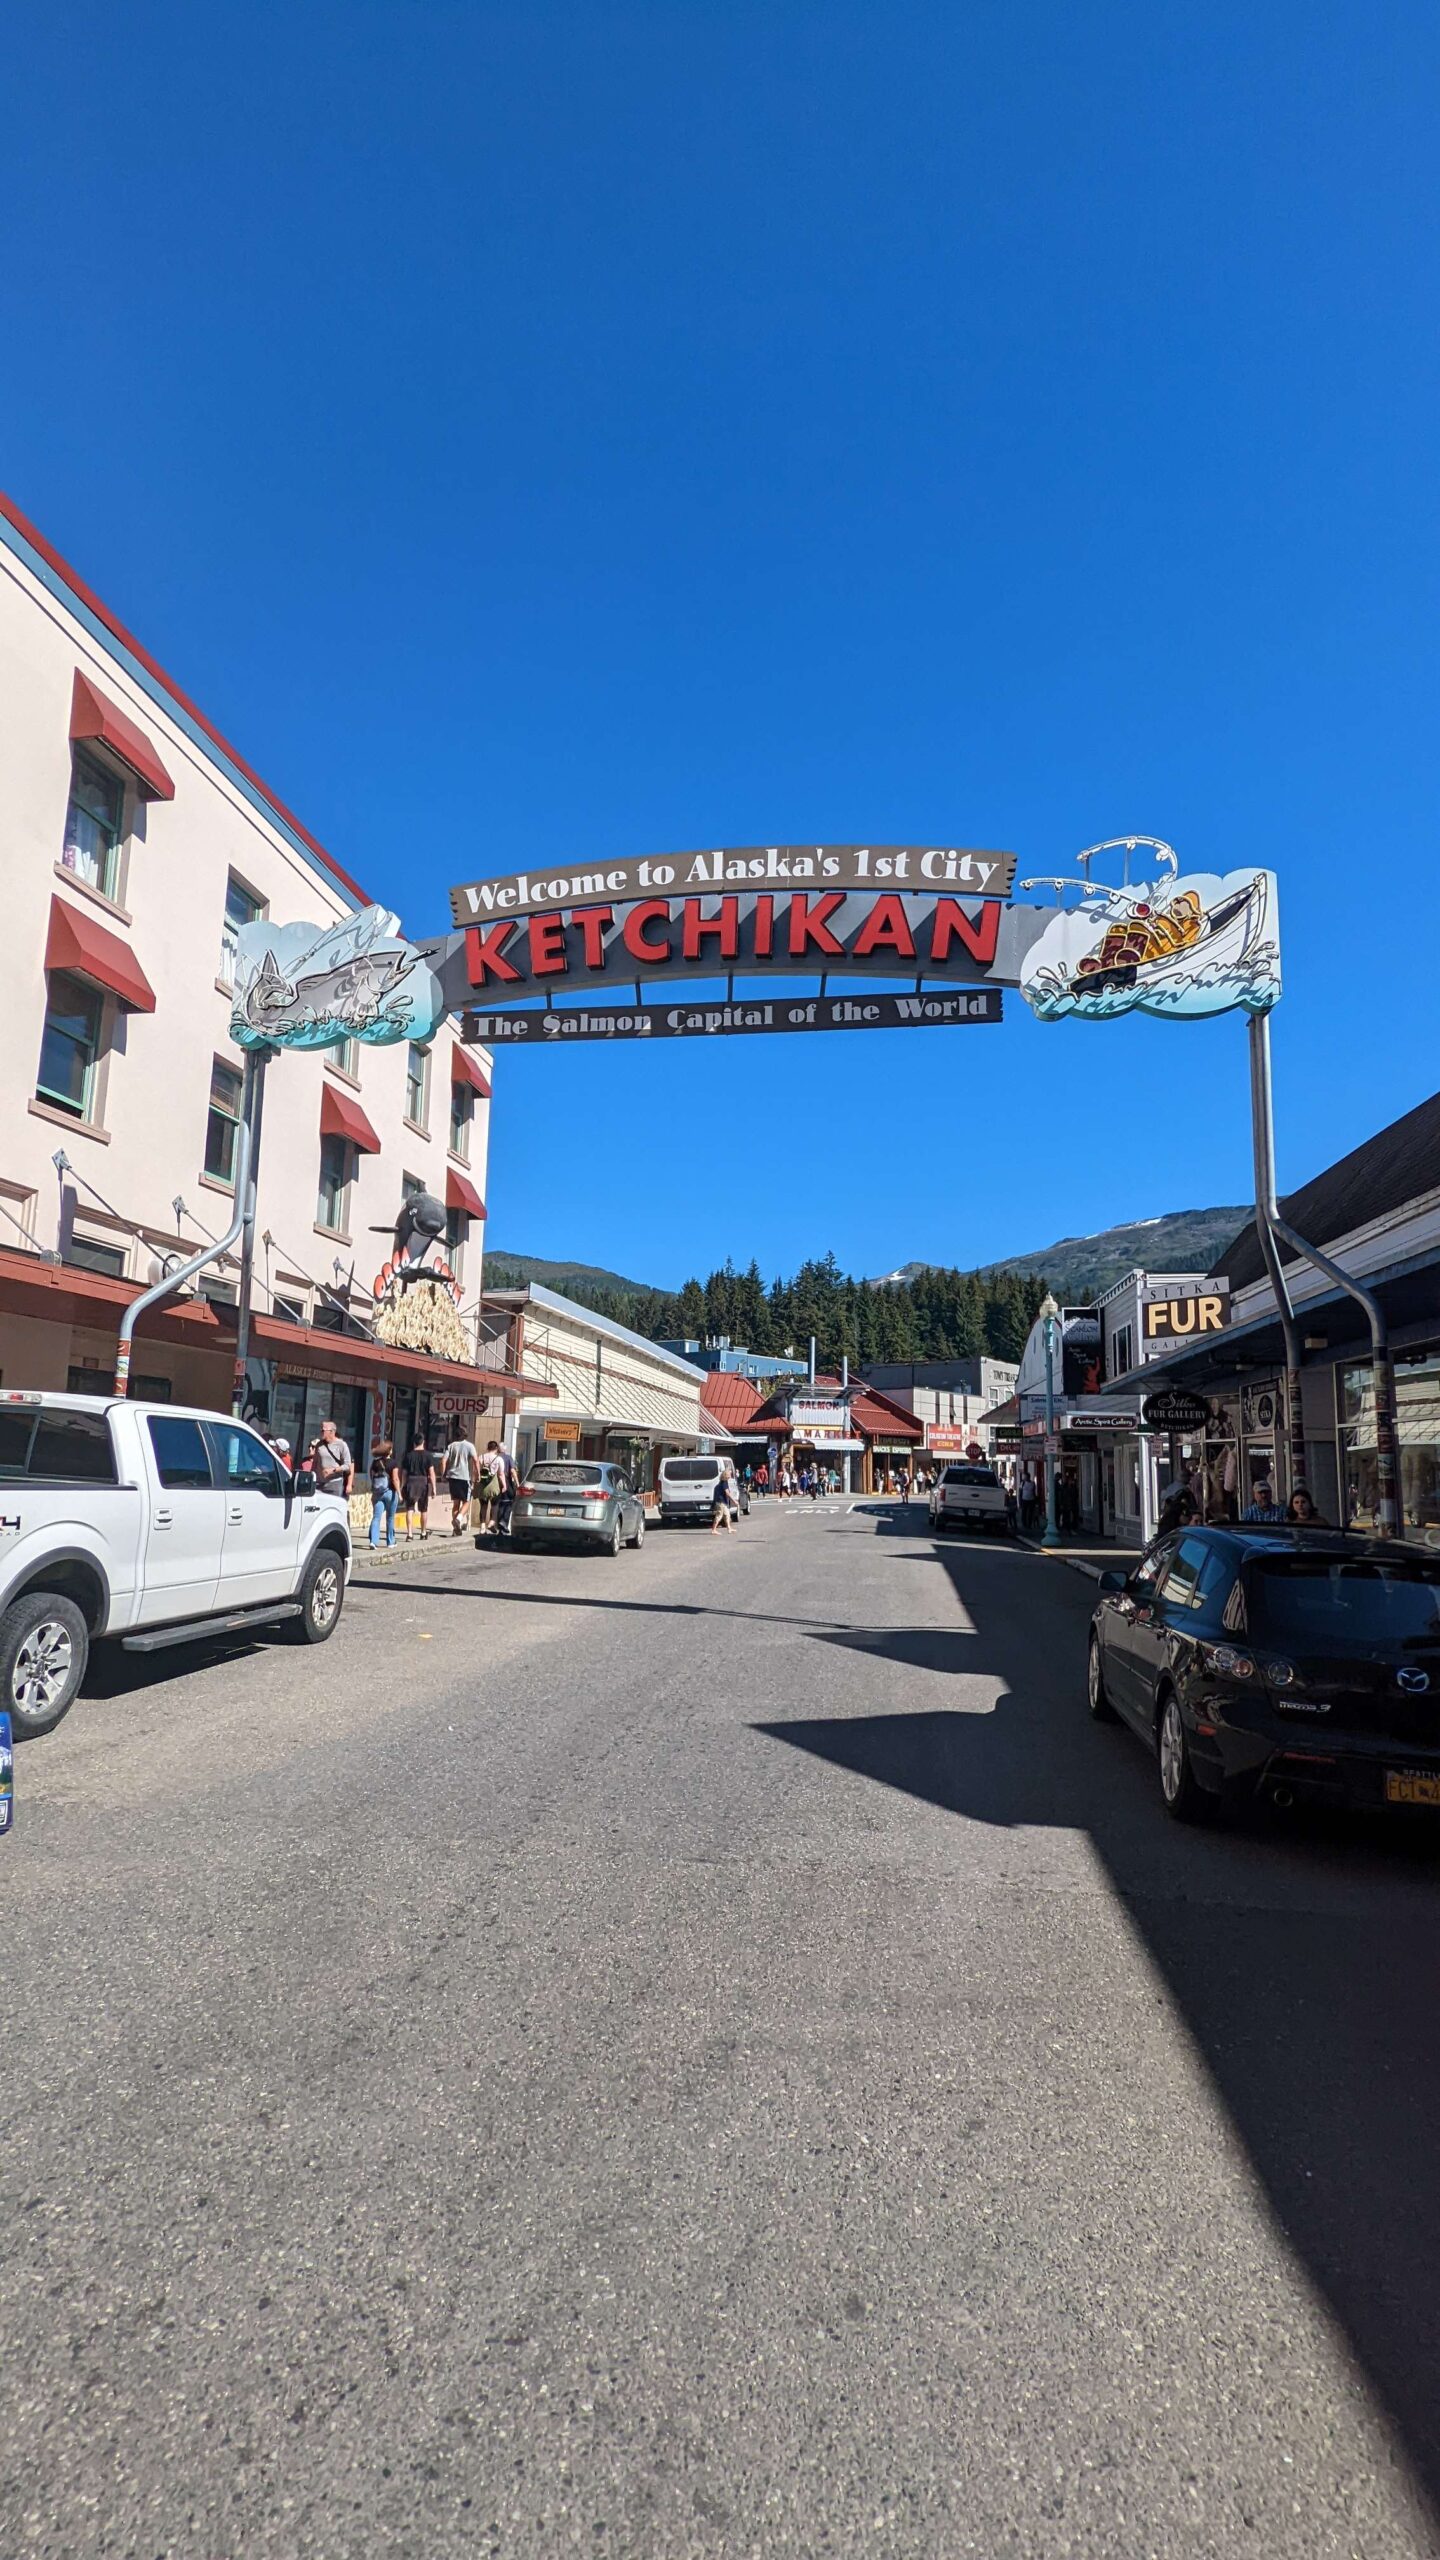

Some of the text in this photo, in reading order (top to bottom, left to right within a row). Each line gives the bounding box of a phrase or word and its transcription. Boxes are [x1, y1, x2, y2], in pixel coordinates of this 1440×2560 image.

[463, 848, 1000, 914] Welcome to Alaska's 1st City
[464, 892, 1002, 989] KETCHIKAN
[473, 995, 988, 1037] The Salmon Capital of the World
[1150, 1281, 1220, 1300] SITKA
[1148, 1296, 1223, 1336] FUR
[434, 1397, 486, 1412] TOURS
[798, 1400, 840, 1410] SALMON
[1093, 1418, 1111, 1426] Spirit
[1111, 1418, 1133, 1426] Gallery
[1148, 1410, 1206, 1419] FUR GALLERY
[803, 1430, 861, 1440] MARKET
